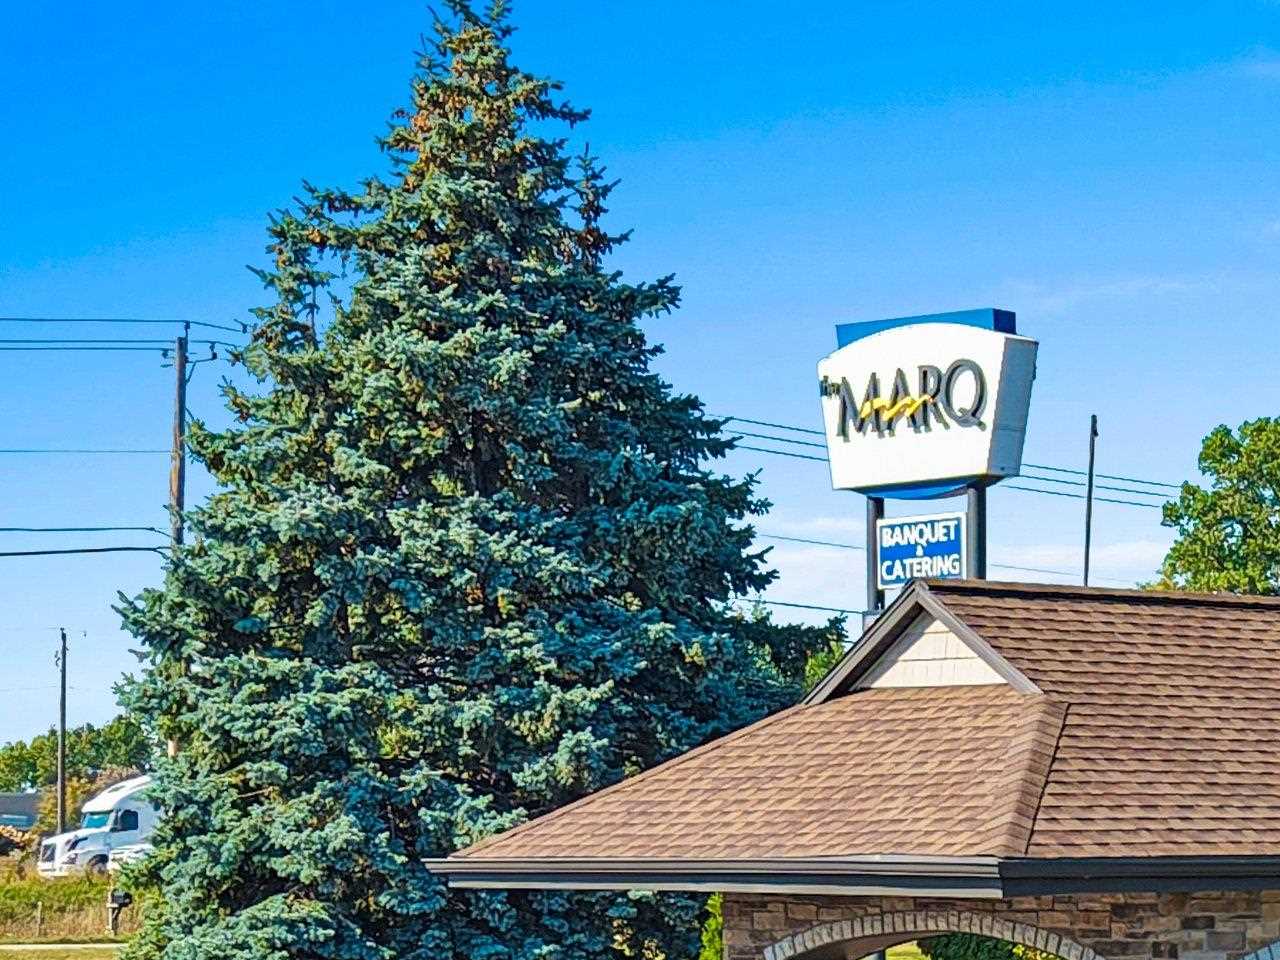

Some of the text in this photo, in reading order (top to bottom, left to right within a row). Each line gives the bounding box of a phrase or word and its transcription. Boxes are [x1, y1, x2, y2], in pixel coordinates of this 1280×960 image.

[837, 359, 987, 442] MARQ
[881, 521, 958, 547] BANQUET
[881, 554, 960, 580] CATERING
